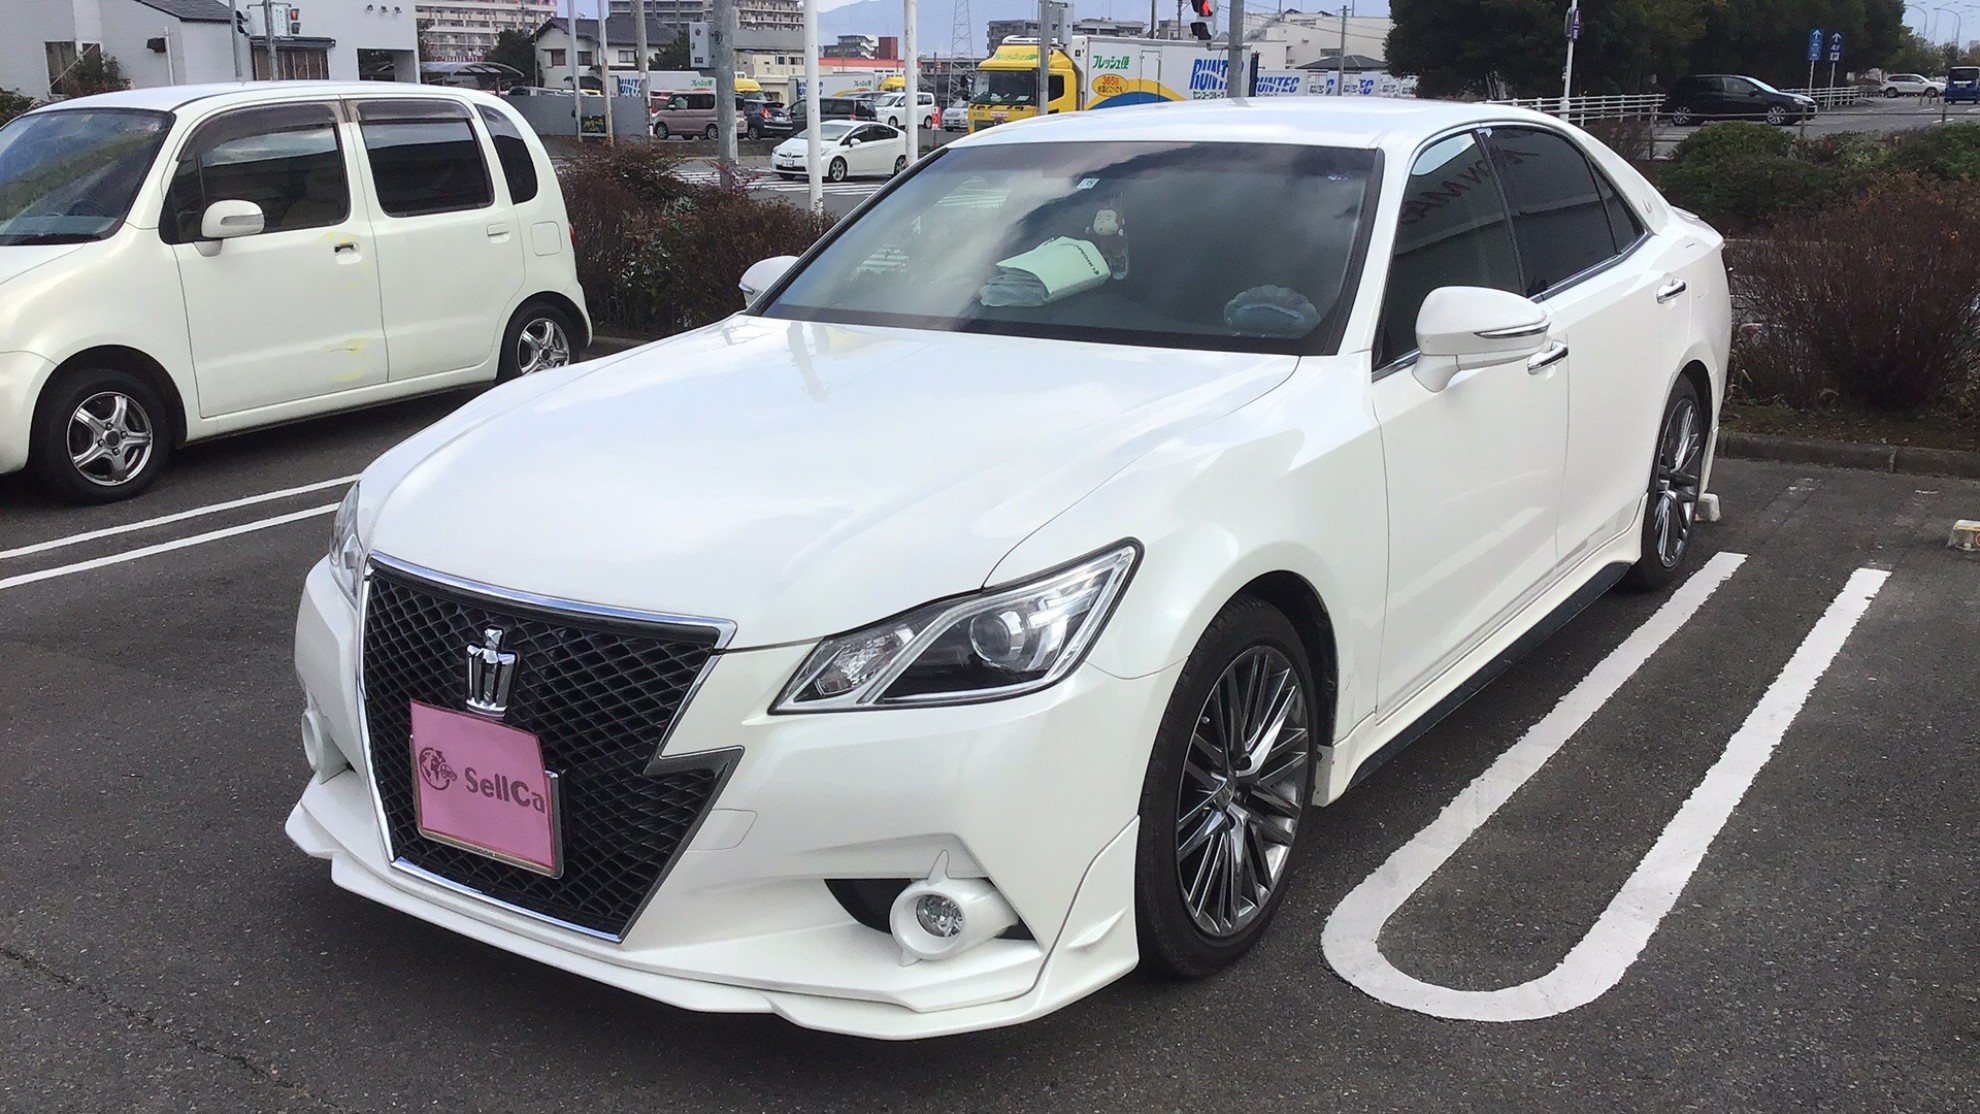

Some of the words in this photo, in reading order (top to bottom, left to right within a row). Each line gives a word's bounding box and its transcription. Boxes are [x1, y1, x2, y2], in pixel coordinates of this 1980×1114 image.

[1092, 55, 1130, 69] フレッシュ便
[1189, 59, 1244, 90] RUNT
[1257, 77, 1300, 93] UNTEC
[464, 766, 545, 814] SellCa
